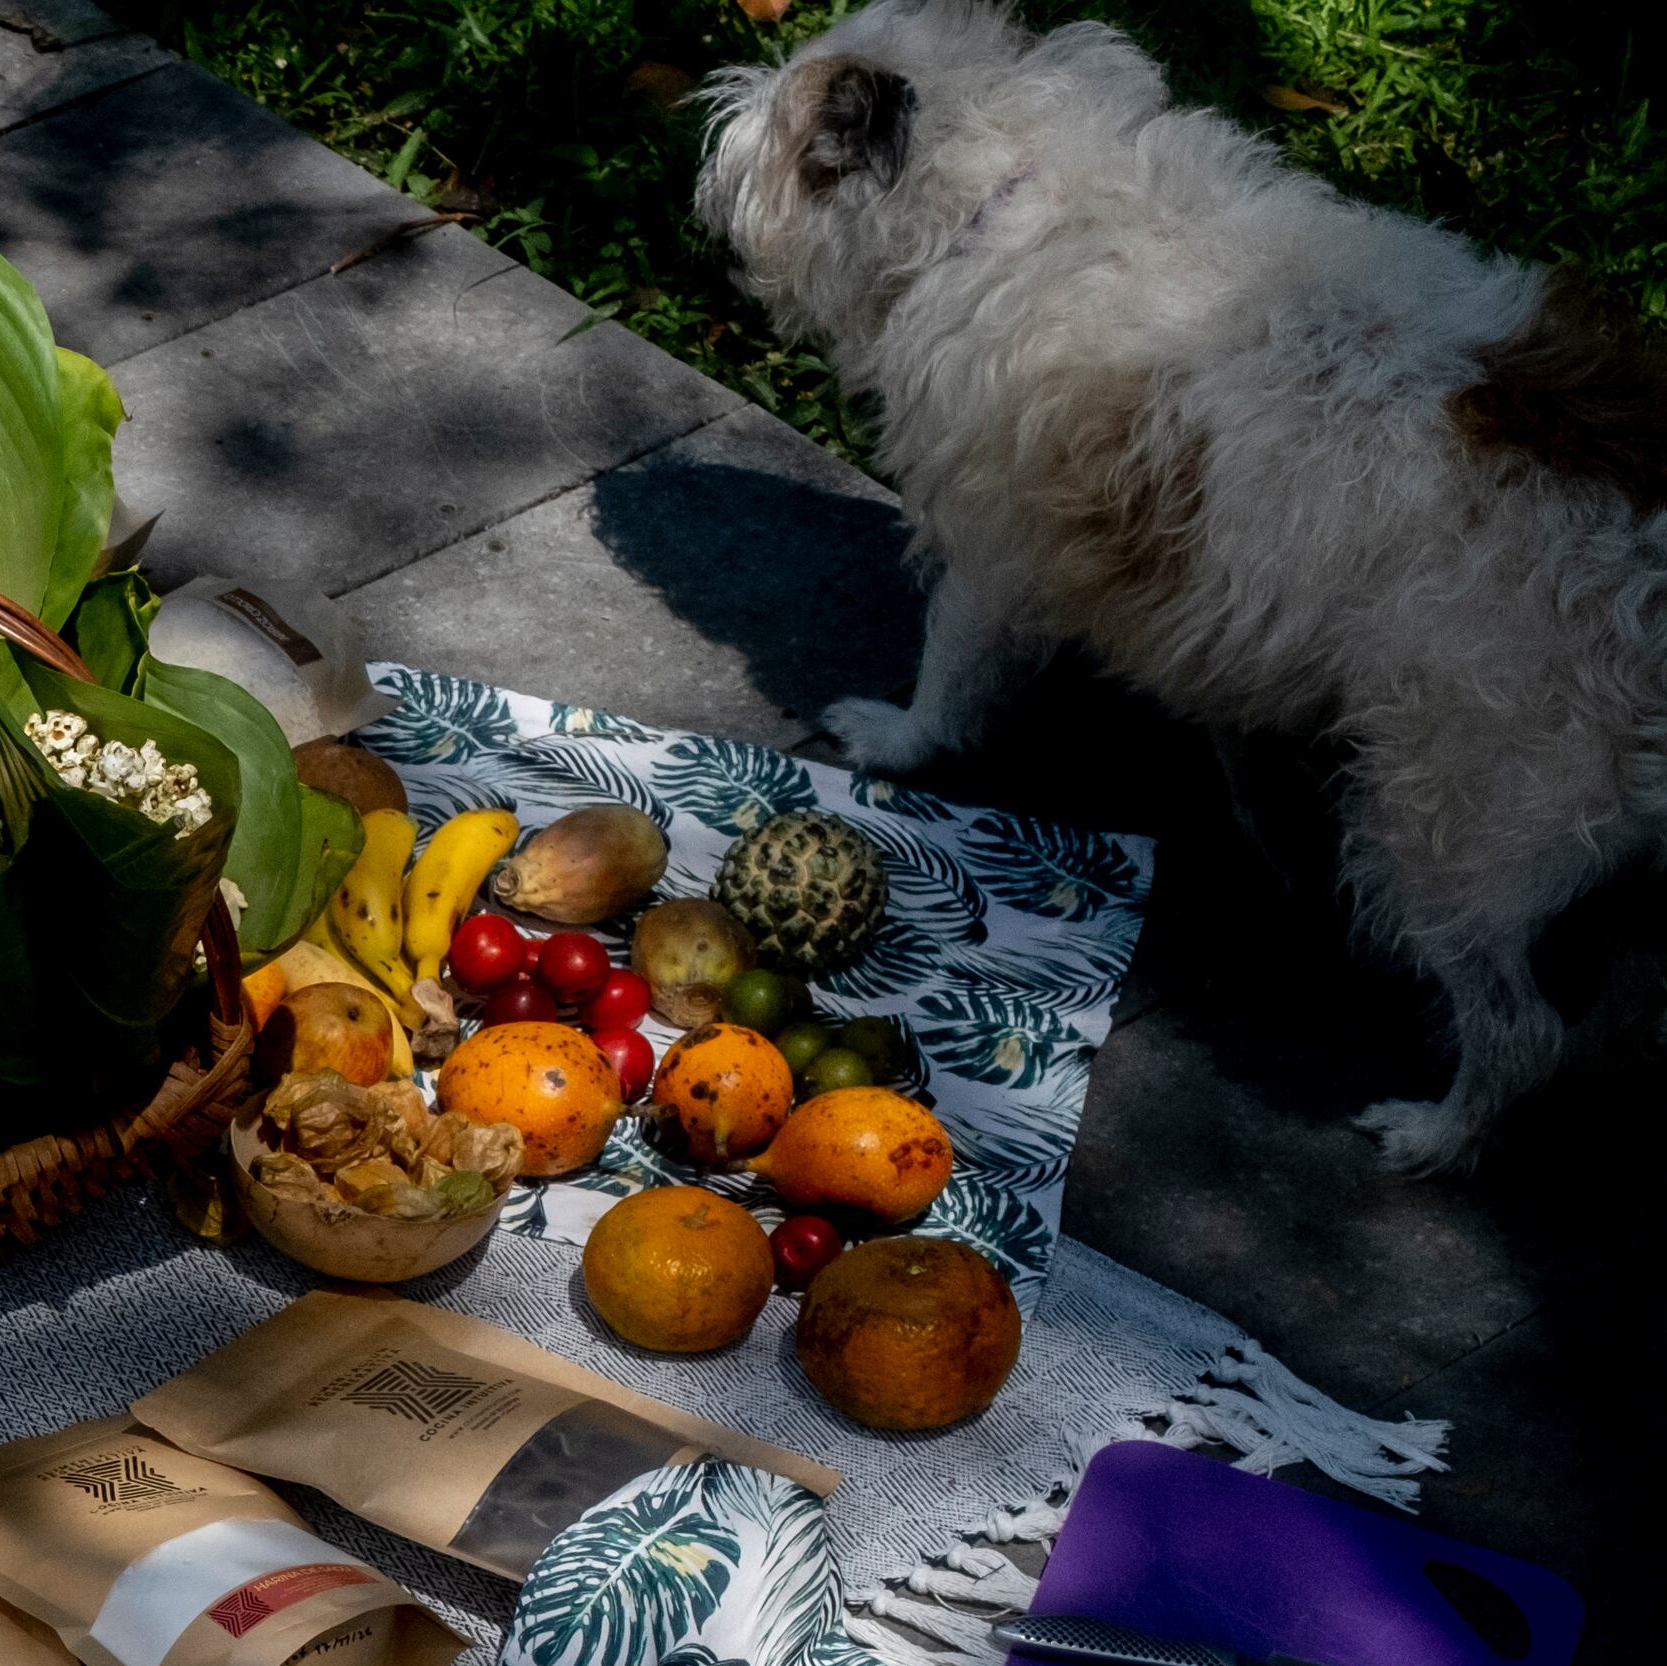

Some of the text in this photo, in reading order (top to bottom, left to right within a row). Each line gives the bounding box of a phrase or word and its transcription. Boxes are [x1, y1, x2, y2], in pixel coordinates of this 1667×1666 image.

[419, 1409, 462, 1442] COCINA
[459, 1377, 516, 1409] INTUITIVA
[254, 1569, 301, 1592] HARINA
